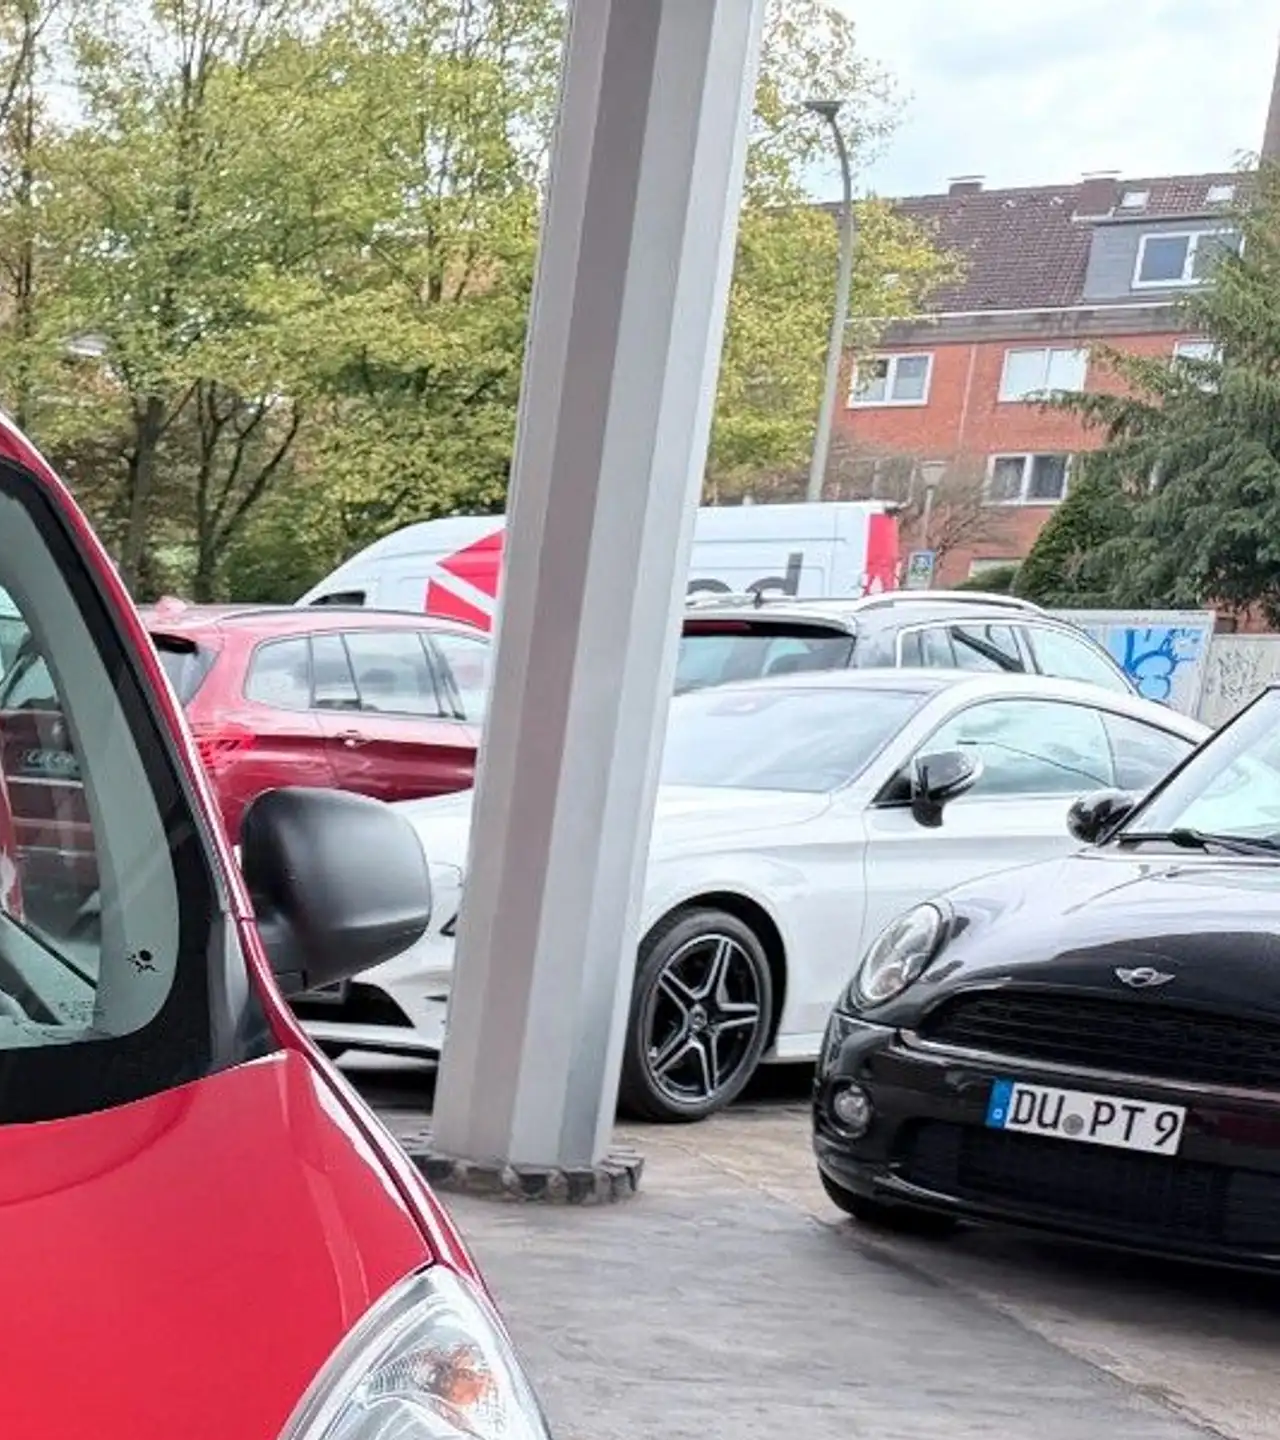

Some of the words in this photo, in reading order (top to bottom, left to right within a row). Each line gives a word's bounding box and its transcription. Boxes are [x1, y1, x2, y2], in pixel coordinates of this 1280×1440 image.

[1009, 1089, 1066, 1130] DU
[1089, 1100, 1147, 1142] PT
[1153, 1110, 1180, 1147] 9
